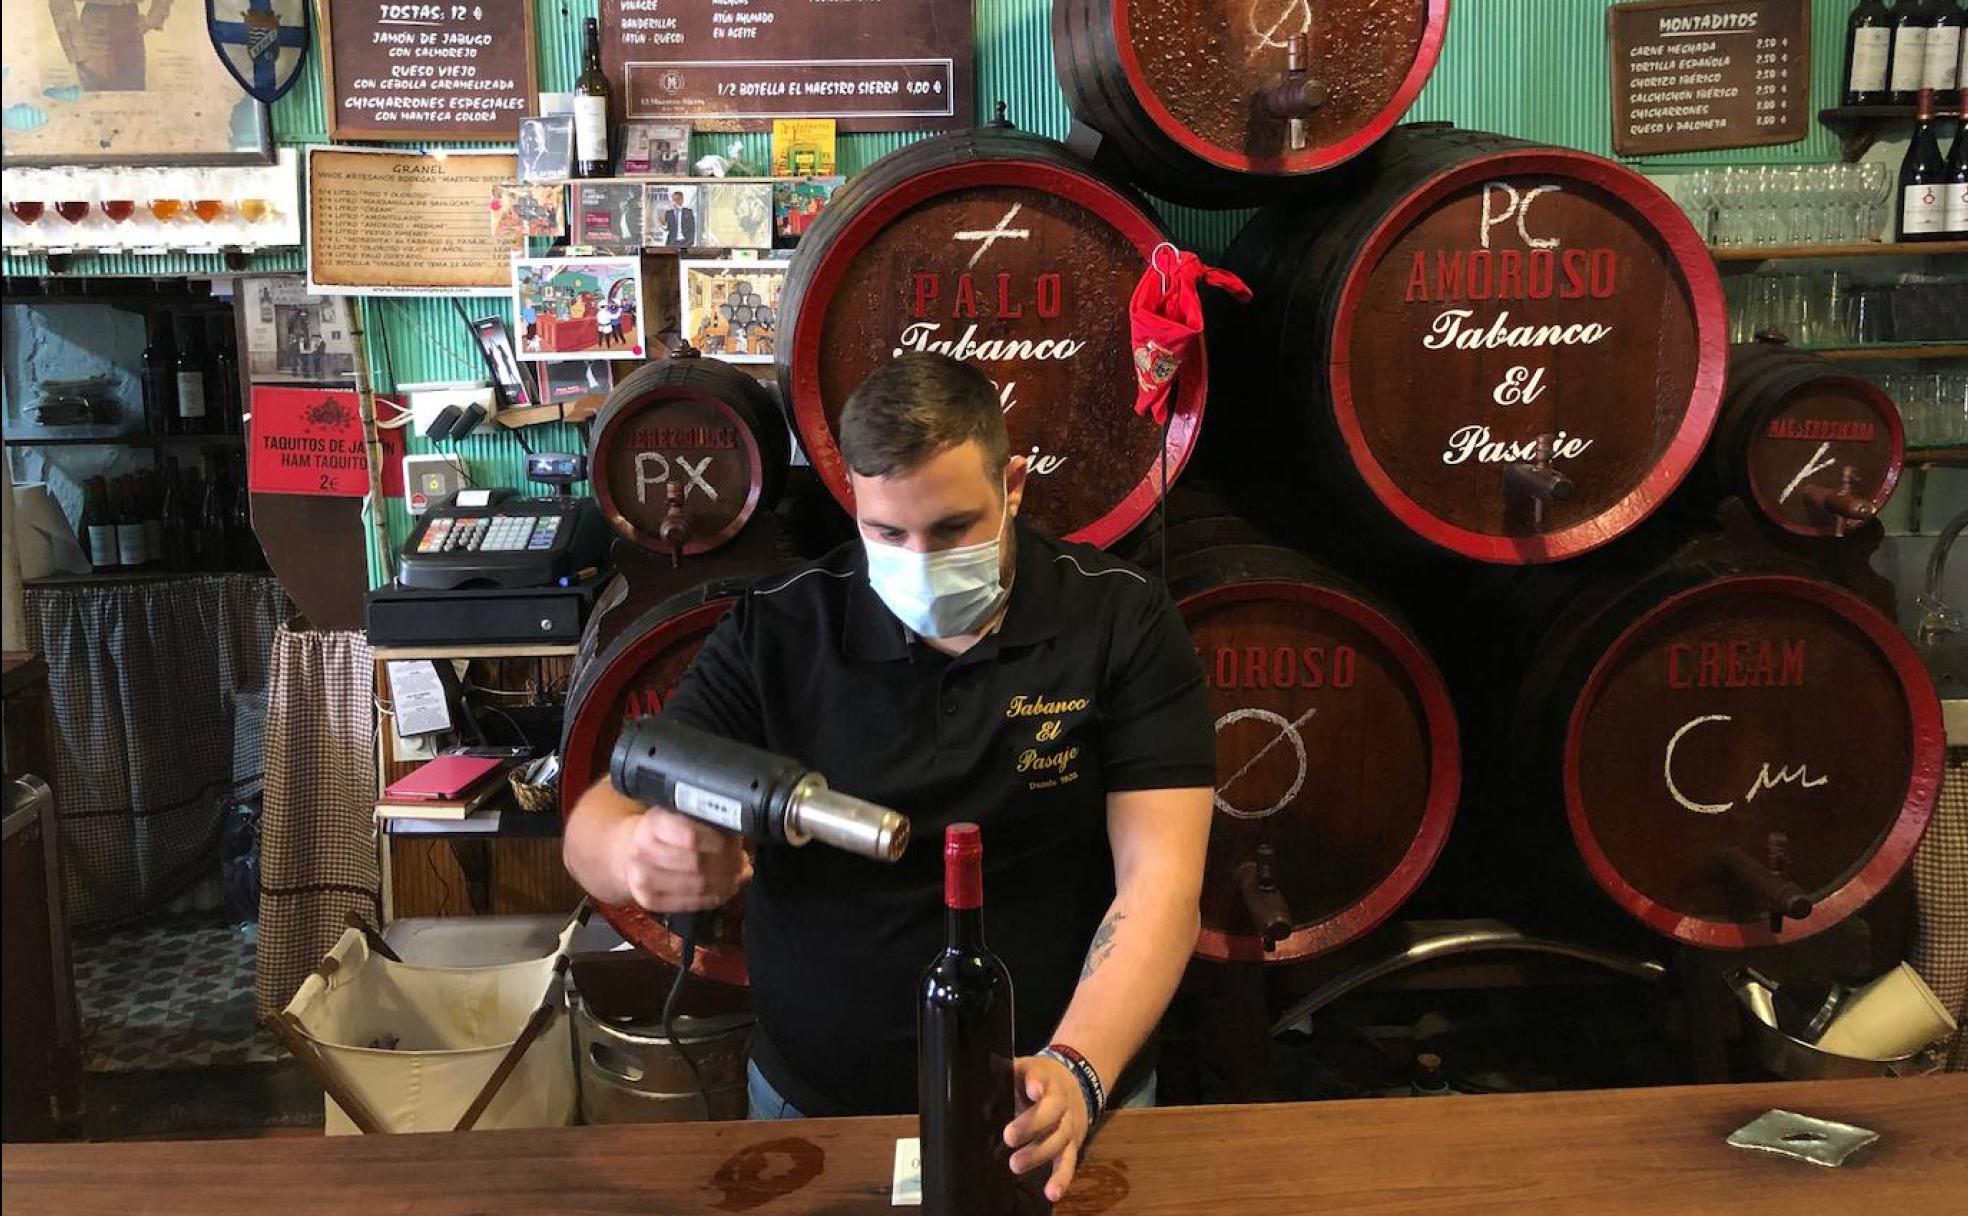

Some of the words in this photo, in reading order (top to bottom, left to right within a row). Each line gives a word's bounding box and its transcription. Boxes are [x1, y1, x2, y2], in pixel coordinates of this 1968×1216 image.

[380, 4, 446, 20] TOSTAS:
[451, 5, 467, 20] 12
[621, 0, 657, 12] VINAGRE
[621, 17, 677, 31] BANDERILLAS
[712, 11, 734, 24] ATÚN
[735, 12, 774, 26] AHUMADO
[1660, 12, 1758, 32] MONTADITOS
[372, 31, 415, 44] JAMÓN
[420, 33, 437, 44] DE
[442, 33, 493, 46] JABUGO
[713, 27, 725, 39] EN
[728, 27, 758, 39] ACEITE
[388, 48, 411, 57] CON
[415, 48, 478, 58] SALMOREJO
[1630, 45, 1665, 57] CARNE
[1667, 42, 1716, 54] MECHADA
[391, 65, 435, 78] QUESO
[438, 66, 476, 77] VIEJO
[1630, 60, 1676, 72] TORTILLA
[1679, 56, 1731, 70] ESPAÑOLA
[353, 79, 377, 90] CON
[379, 79, 427, 90] CEBOLLA
[430, 79, 514, 90] CARAMELIZADA
[718, 83, 735, 96] 1/2
[739, 82, 785, 96] BOTELLA
[788, 82, 801, 95] EL
[804, 82, 854, 95] MAESTRO
[857, 81, 899, 95] SIERRA
[1630, 75, 1676, 89] CHORIZO
[345, 97, 444, 110] CHICHARRONES
[450, 97, 525, 109] ESPECIALES
[375, 112, 397, 121] CON
[401, 111, 451, 121] MANTECA
[1630, 105, 1710, 119] CHICHARRONES
[1630, 123, 1664, 136] QUESO
[1666, 122, 1674, 132] Y
[1676, 119, 1727, 132] PALOMETA
[392, 164, 446, 175] GRANEL
[1479, 182, 1562, 249] PC
[1404, 248, 1617, 301] AMOROSO
[914, 272, 1061, 319] PALO
[1423, 308, 1612, 351] Tabanco
[893, 321, 1086, 361] Tabanco
[1492, 365, 1546, 406] El
[263, 436, 325, 452] TAQUITOS
[329, 439, 345, 453] DE
[281, 454, 311, 468] HAM
[320, 474, 339, 491] 2€
[635, 452, 718, 504] PX
[1667, 638, 1807, 690] CREAM
[1006, 695, 1090, 718] Tabanco
[1036, 720, 1062, 742] El
[1017, 746, 1079, 773] Pasaje
